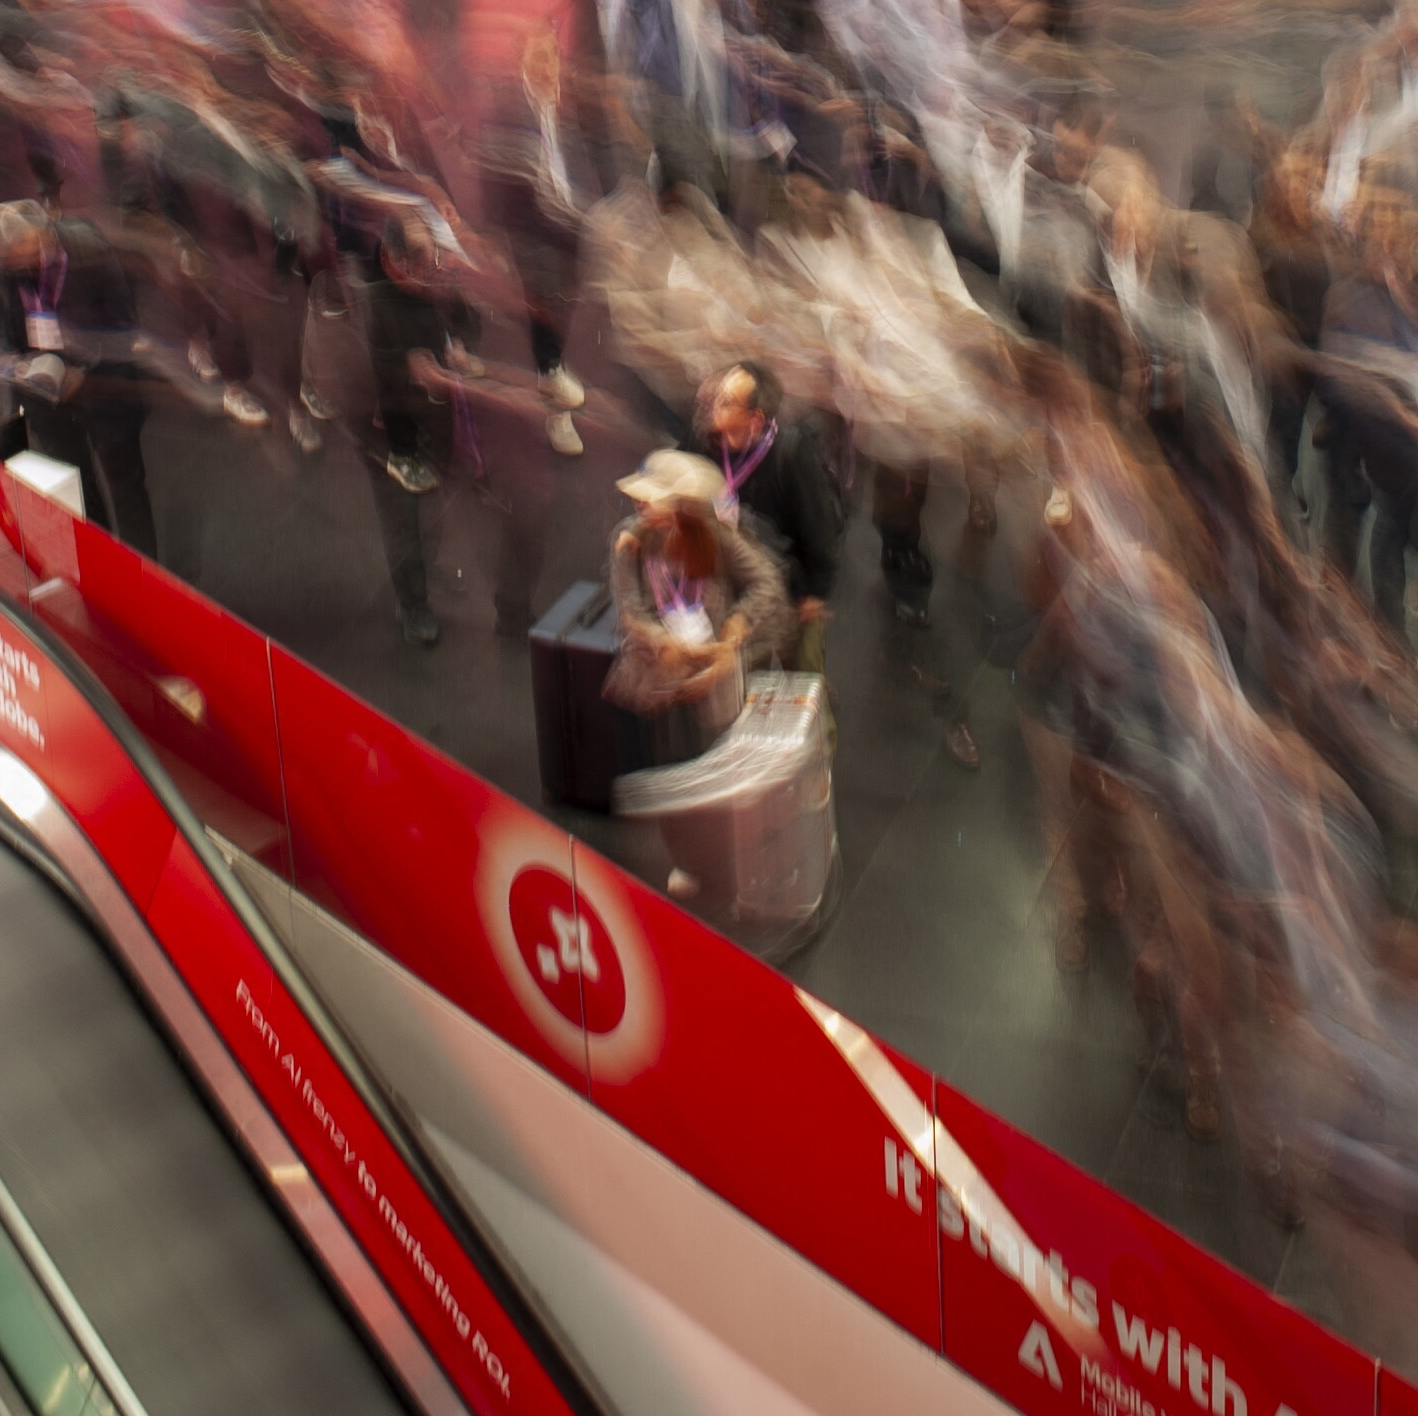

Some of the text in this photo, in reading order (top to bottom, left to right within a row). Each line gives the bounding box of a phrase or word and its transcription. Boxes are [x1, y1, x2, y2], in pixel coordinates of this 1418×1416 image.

[236, 977, 280, 1060] From
[282, 1052, 302, 1089] AI
[303, 1078, 356, 1166] frenzy
[358, 1159, 377, 1201] to
[379, 1194, 471, 1340] marketing
[884, 1135, 1248, 1416] It starts with
